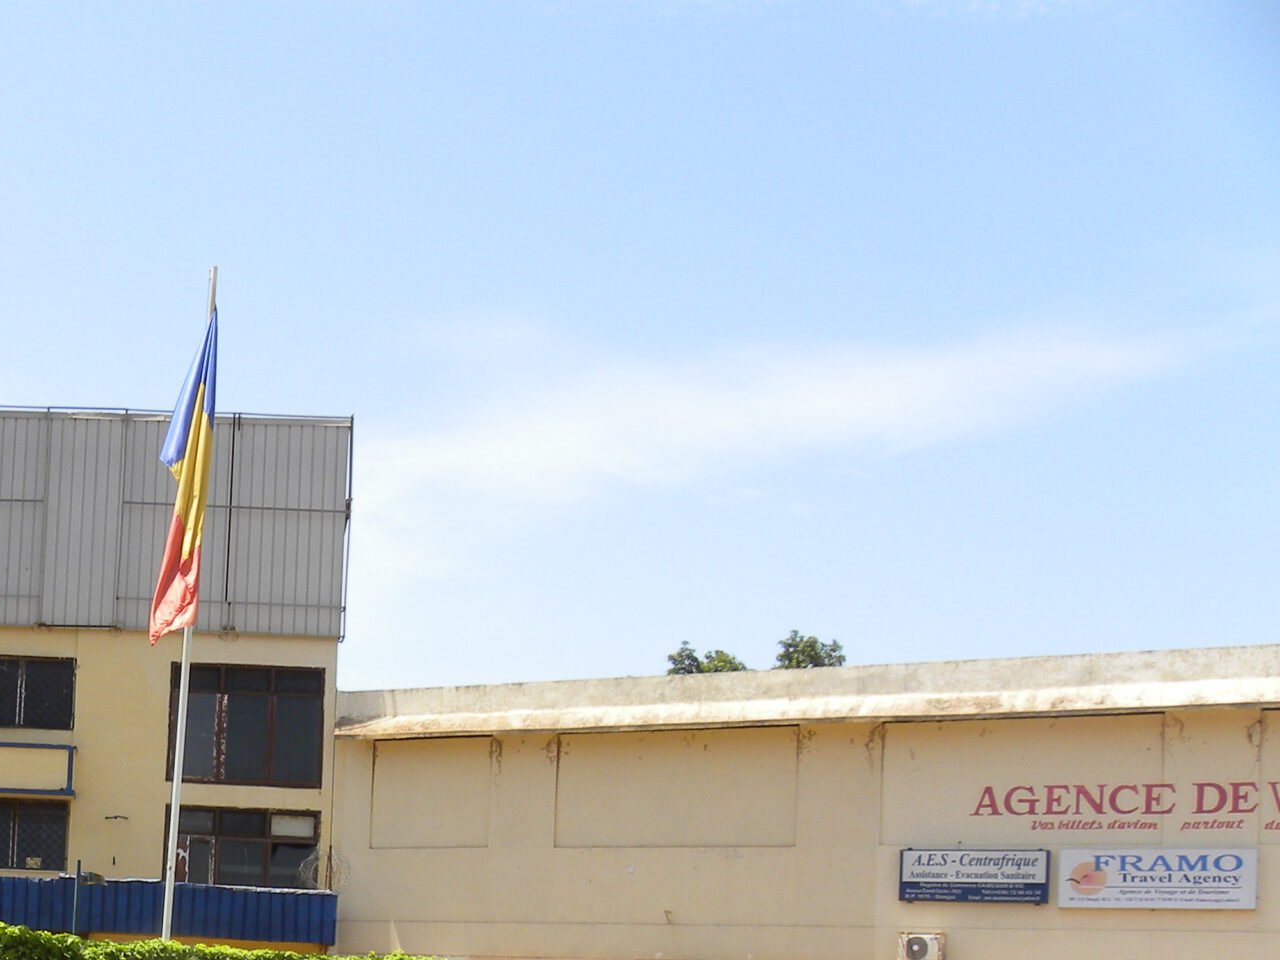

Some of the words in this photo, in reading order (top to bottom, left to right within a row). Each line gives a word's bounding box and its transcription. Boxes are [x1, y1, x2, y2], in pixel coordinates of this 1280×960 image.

[969, 783, 1176, 816] AGENCE
[1191, 782, 1259, 815] DE
[1030, 820, 1055, 831] Vos
[1057, 819, 1103, 831] billets
[1180, 819, 1244, 831] partout
[912, 853, 949, 867] A.E.S
[959, 853, 1039, 870] Centrafrique
[1092, 854, 1244, 872] FRAMO
[909, 871, 949, 880] Assistance
[955, 870, 999, 880] Evacuation
[1000, 871, 1037, 880] Sanitaire
[1118, 873, 1172, 884] Travel
[1179, 873, 1242, 886] Agency
